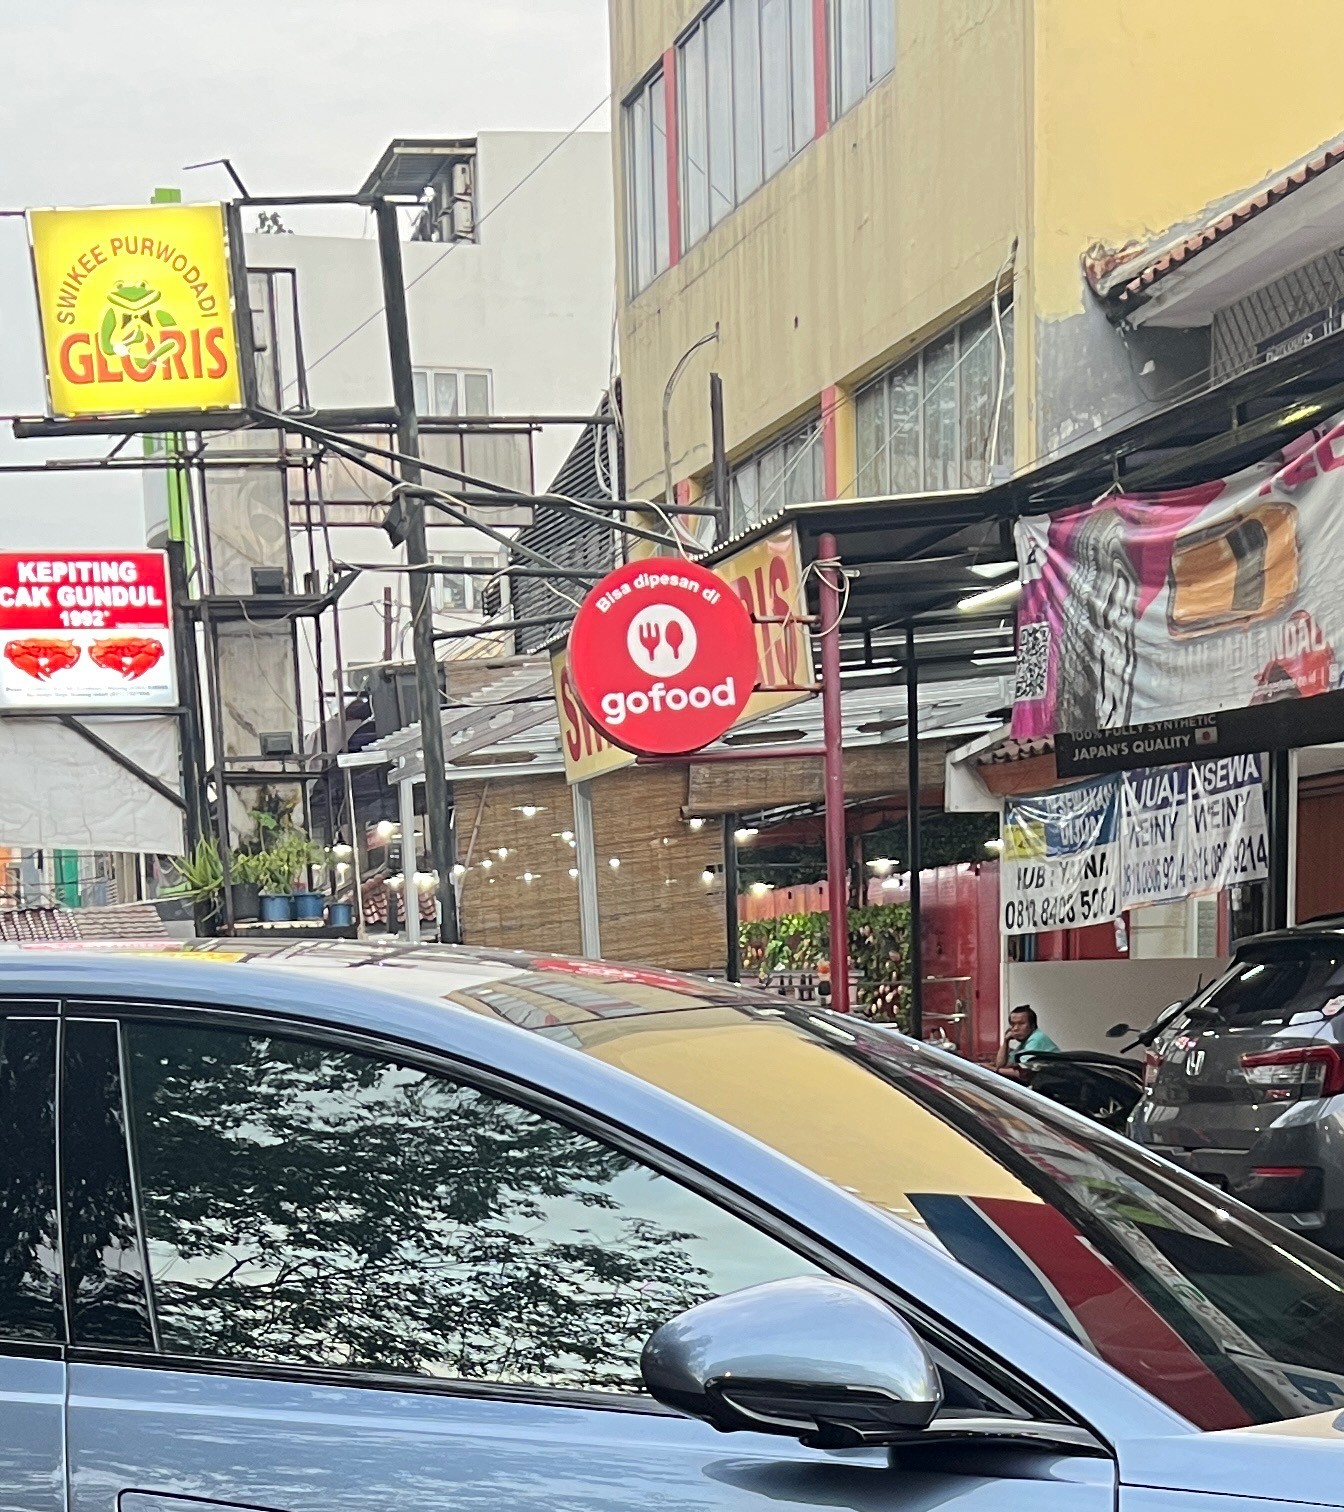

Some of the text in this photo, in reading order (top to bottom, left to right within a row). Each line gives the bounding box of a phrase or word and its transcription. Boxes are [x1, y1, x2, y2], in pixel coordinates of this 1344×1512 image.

[56, 235, 219, 325] SWIKEE PURWODADI
[59, 326, 228, 385] GLORIS
[17, 560, 137, 583] KEPITING
[56, 585, 163, 608] GUNDUL
[595, 573, 722, 613] Bisa dipesan di
[601, 676, 736, 725] gofood
[1072, 734, 1191, 761] JAPAN'S QUALITY
